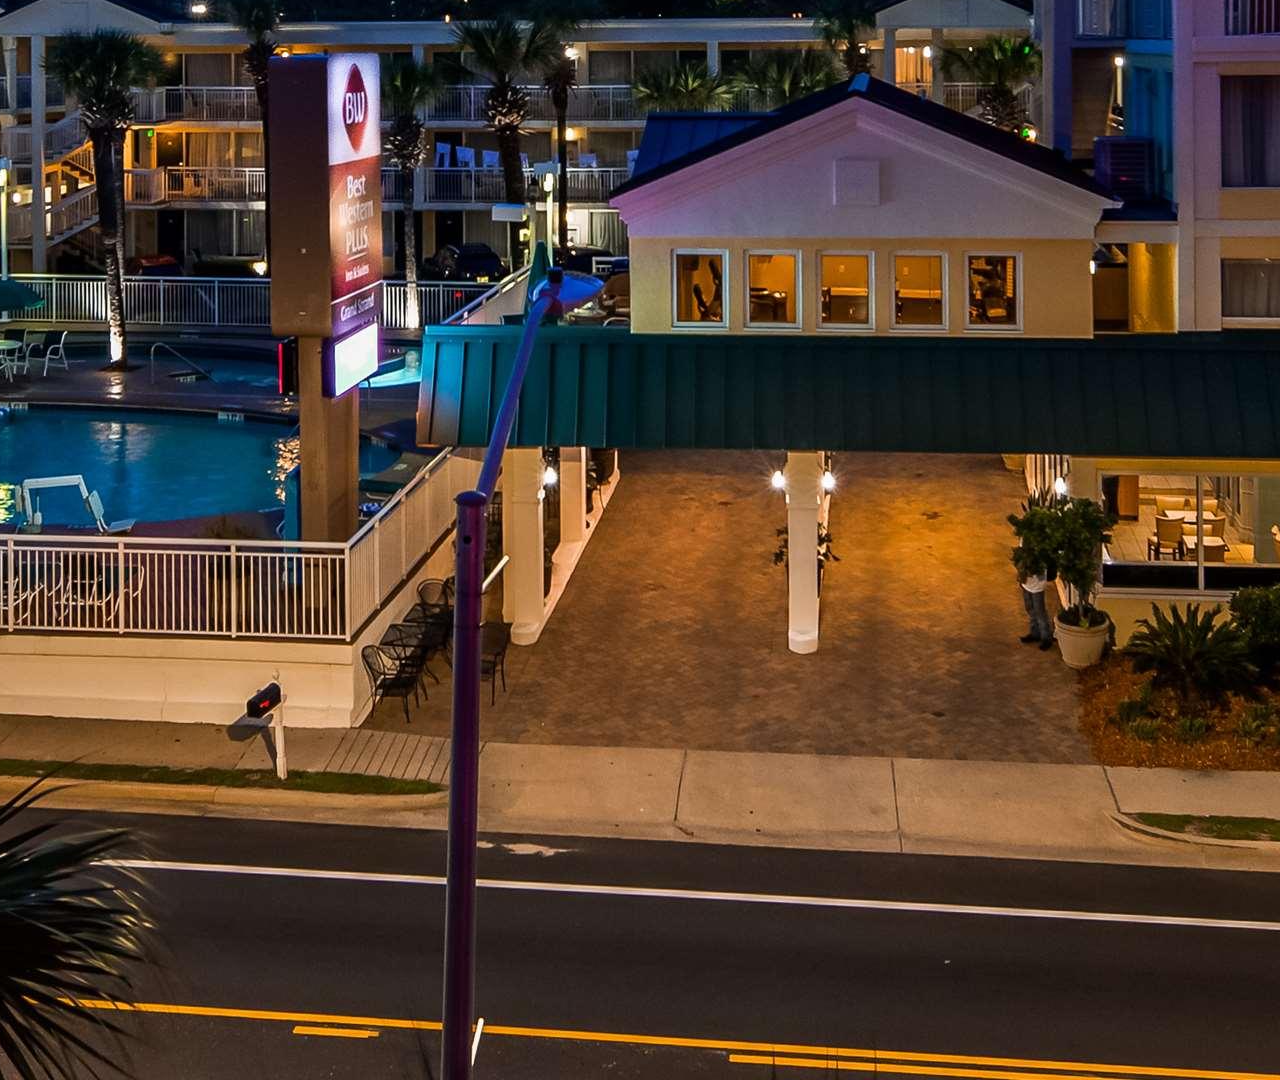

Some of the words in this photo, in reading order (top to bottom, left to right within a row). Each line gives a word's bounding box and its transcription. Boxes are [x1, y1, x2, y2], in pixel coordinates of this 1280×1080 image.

[345, 91, 365, 125] BW
[346, 173, 367, 199] Best
[338, 200, 374, 224] Western
[345, 225, 369, 255] PLUS
